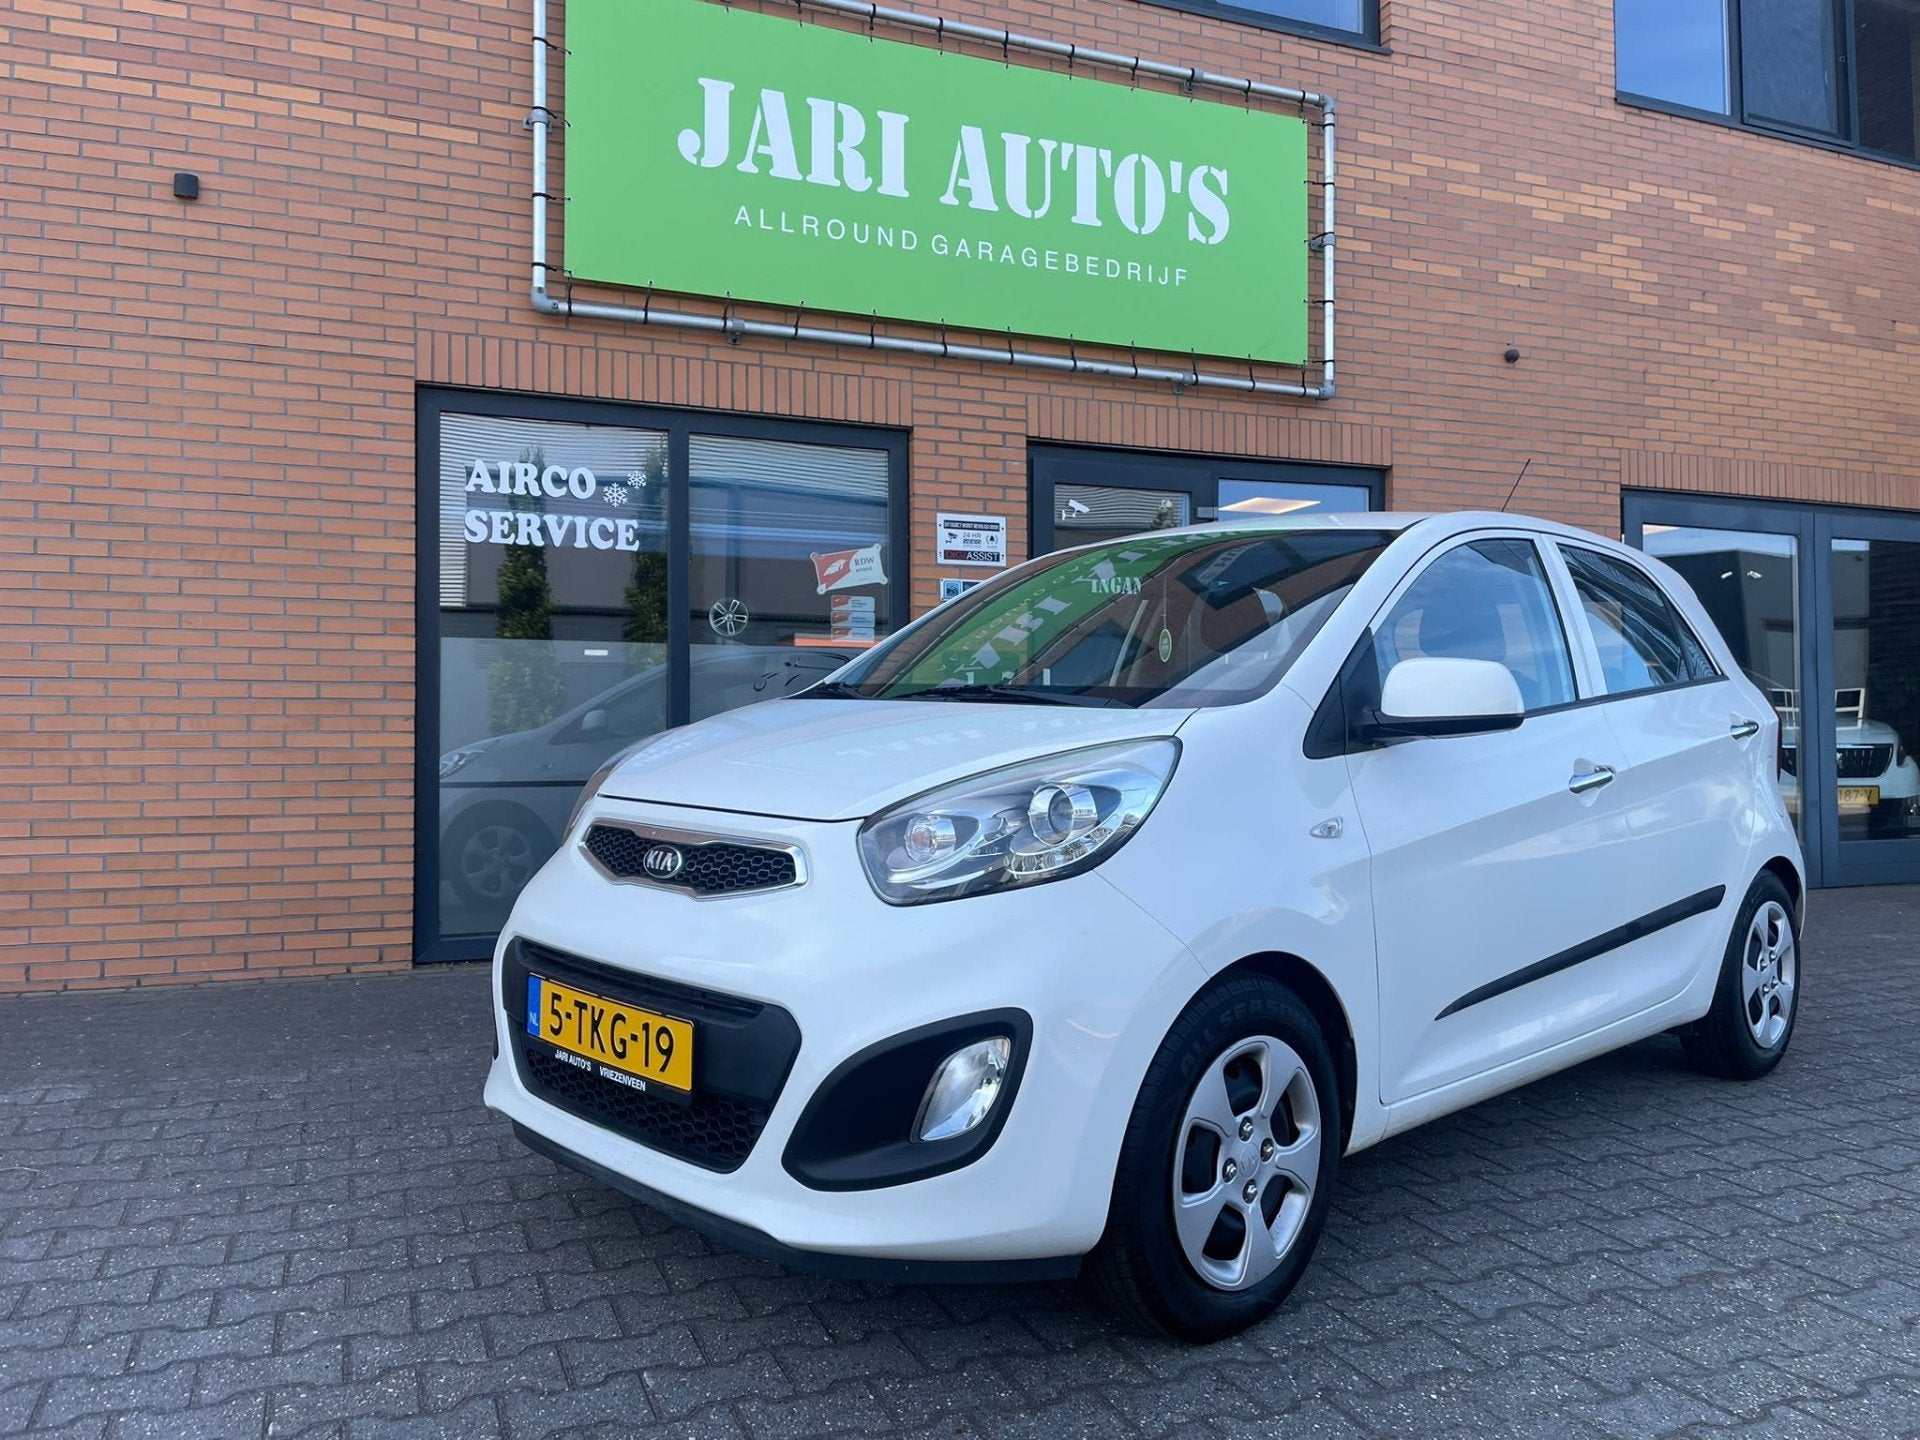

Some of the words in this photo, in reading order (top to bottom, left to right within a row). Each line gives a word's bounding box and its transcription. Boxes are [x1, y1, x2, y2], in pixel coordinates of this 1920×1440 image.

[677, 77, 910, 198] JARI
[940, 125, 1230, 246] AUTO'S
[735, 205, 919, 251] ALLROUND
[931, 234, 1189, 287] GARAGEBEDRIJF
[465, 459, 596, 499] AIRCO
[464, 509, 640, 552] SERVICE
[854, 556, 875, 567] RDW
[647, 850, 672, 871] KIA
[529, 1012, 539, 1026] NL
[550, 991, 675, 1073] 5-TKG-19
[554, 1049, 568, 1063] JARI
[568, 1054, 592, 1072] AUTO'S
[599, 1065, 646, 1092] VRIEZENVEEN
